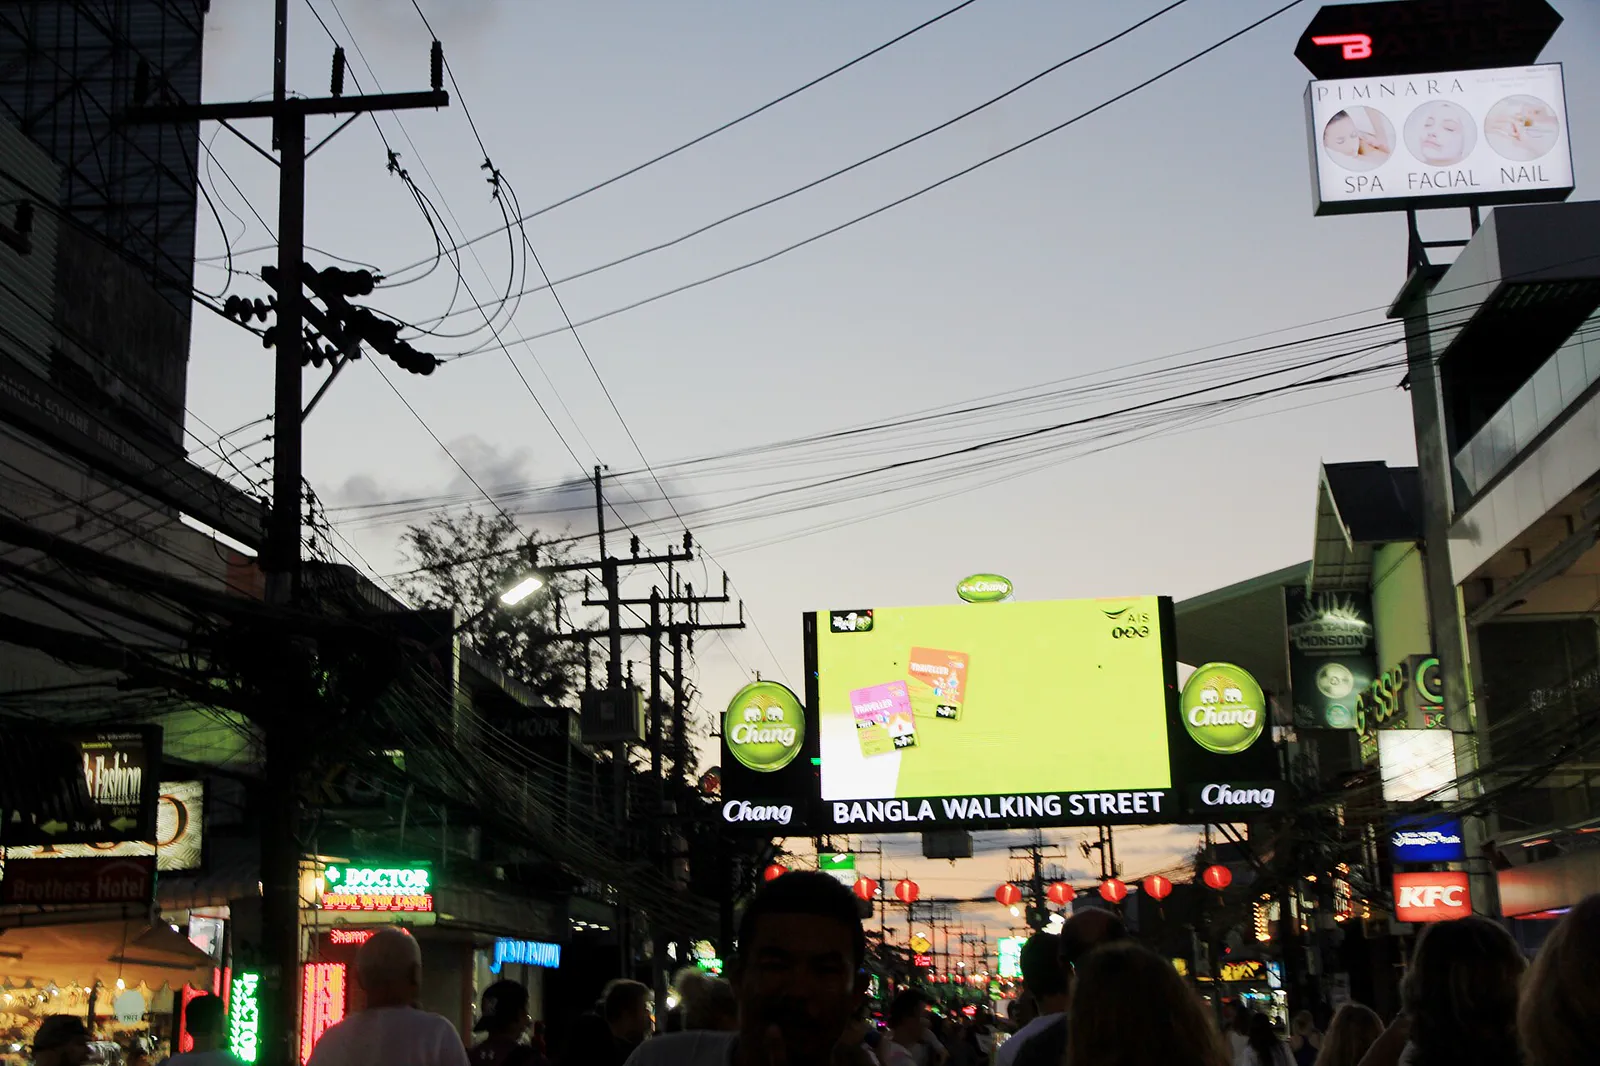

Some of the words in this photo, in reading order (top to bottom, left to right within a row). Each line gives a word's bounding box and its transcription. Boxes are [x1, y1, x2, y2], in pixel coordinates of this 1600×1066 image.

[1316, 78, 1465, 102] PIMNARA
[1344, 175, 1385, 194] SPA
[1408, 168, 1481, 189] FACIAL
[1500, 164, 1550, 184] NAIL
[1299, 634, 1364, 647] MONSOON
[1188, 705, 1257, 729] Chang
[731, 723, 797, 747] Chang
[832, 799, 936, 824] BANGLA
[942, 795, 1062, 820] WALKING
[1069, 791, 1165, 816] STREET
[1201, 783, 1275, 808] Chang
[722, 800, 793, 825] Chang
[12, 876, 91, 901] Brothers
[97, 872, 146, 899] Hotel
[344, 868, 429, 888] DOCTOR
[1397, 885, 1465, 908] KFC
